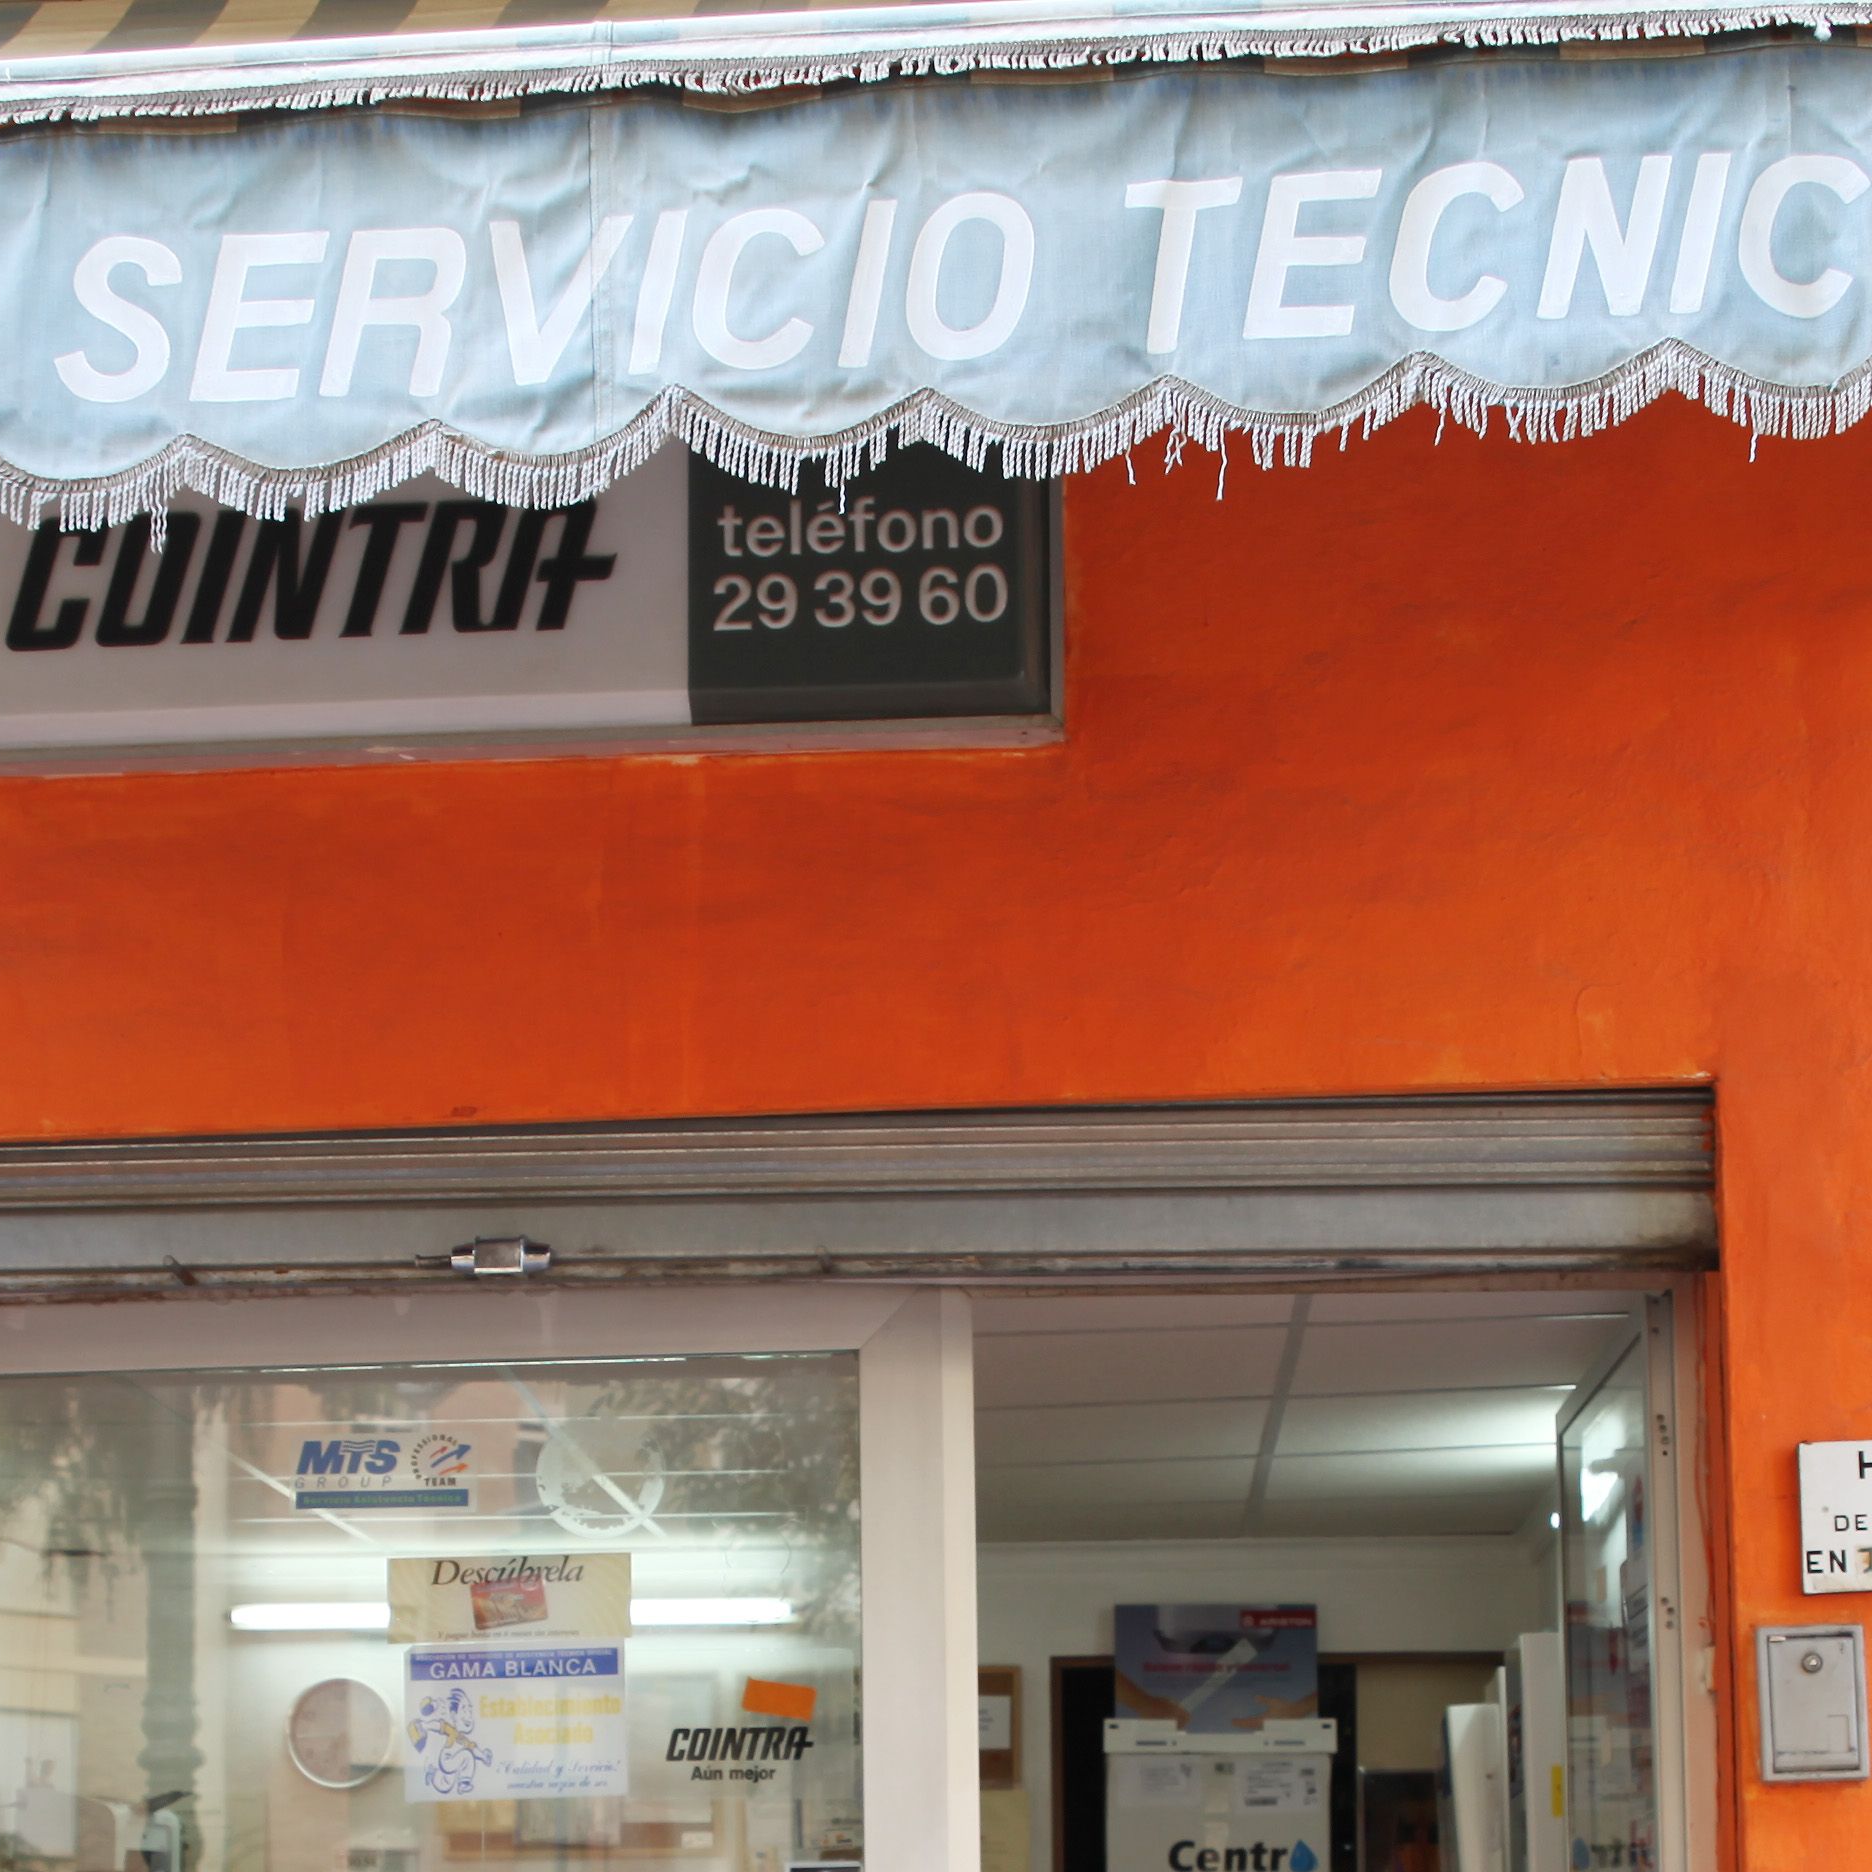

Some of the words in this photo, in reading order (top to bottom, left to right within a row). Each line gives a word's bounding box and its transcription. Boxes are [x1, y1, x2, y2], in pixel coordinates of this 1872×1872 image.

[55, 189, 1037, 404] SERVICIO
[718, 497, 1005, 559] teléfono
[5, 497, 617, 652] COINTRA
[713, 572, 797, 633] 29
[813, 568, 898, 629] 39
[917, 564, 1008, 627] 60
[296, 1439, 401, 1475] MTS
[294, 1477, 392, 1489] GROUP
[424, 1478, 457, 1488] TEAM
[1834, 1513, 1868, 1532] DE
[431, 1553, 585, 1586] Descúbrela
[1806, 1550, 1847, 1574] EN
[430, 1660, 497, 1679] GAMA
[504, 1658, 597, 1677] BLANCA
[479, 1694, 621, 1718] Establecimiento
[513, 1722, 594, 1745] Asociado
[665, 1726, 814, 1764] COINTRA
[691, 1764, 725, 1782] Aún
[729, 1765, 777, 1785] mejor
